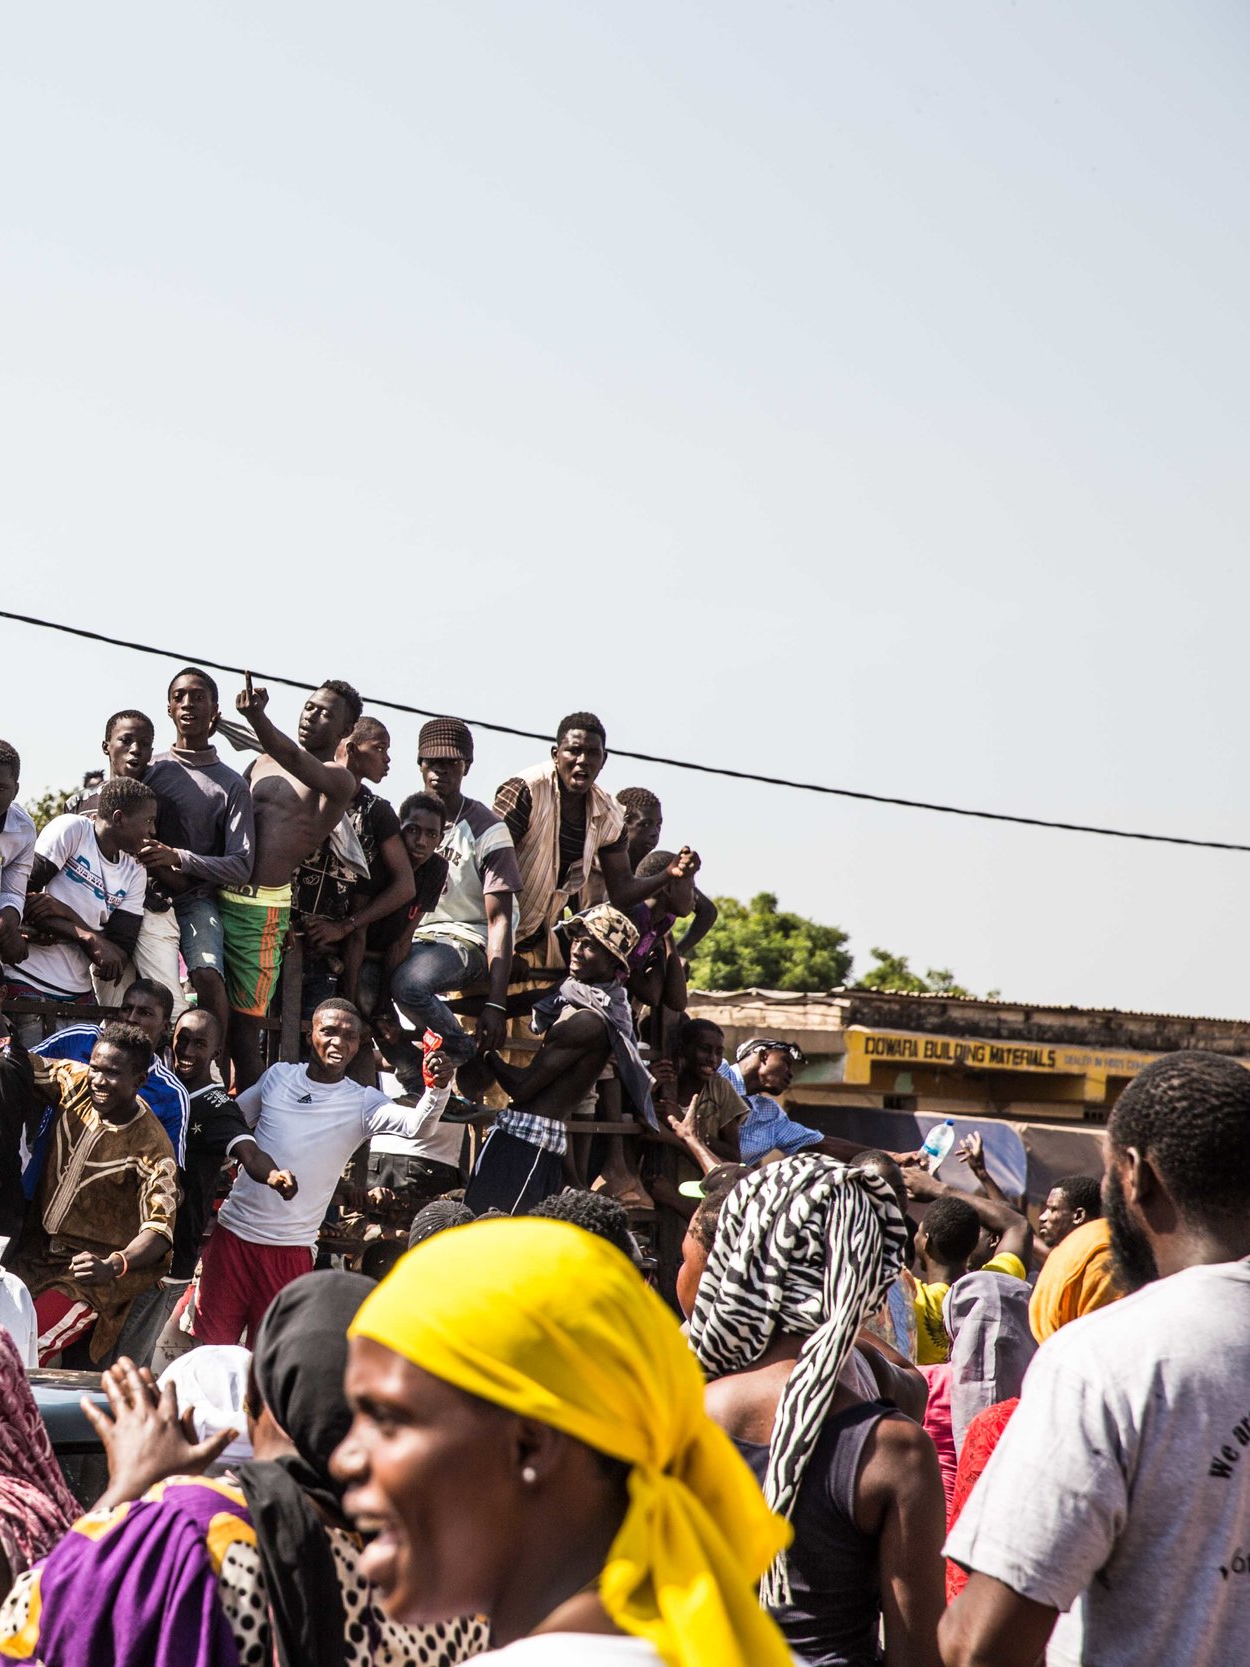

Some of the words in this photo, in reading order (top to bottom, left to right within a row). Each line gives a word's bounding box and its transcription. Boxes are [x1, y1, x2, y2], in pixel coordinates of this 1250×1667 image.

[924, 1039, 986, 1062] BUILDING
[989, 1045, 1056, 1068] MATERIALS
[1208, 1444, 1240, 1479] We
